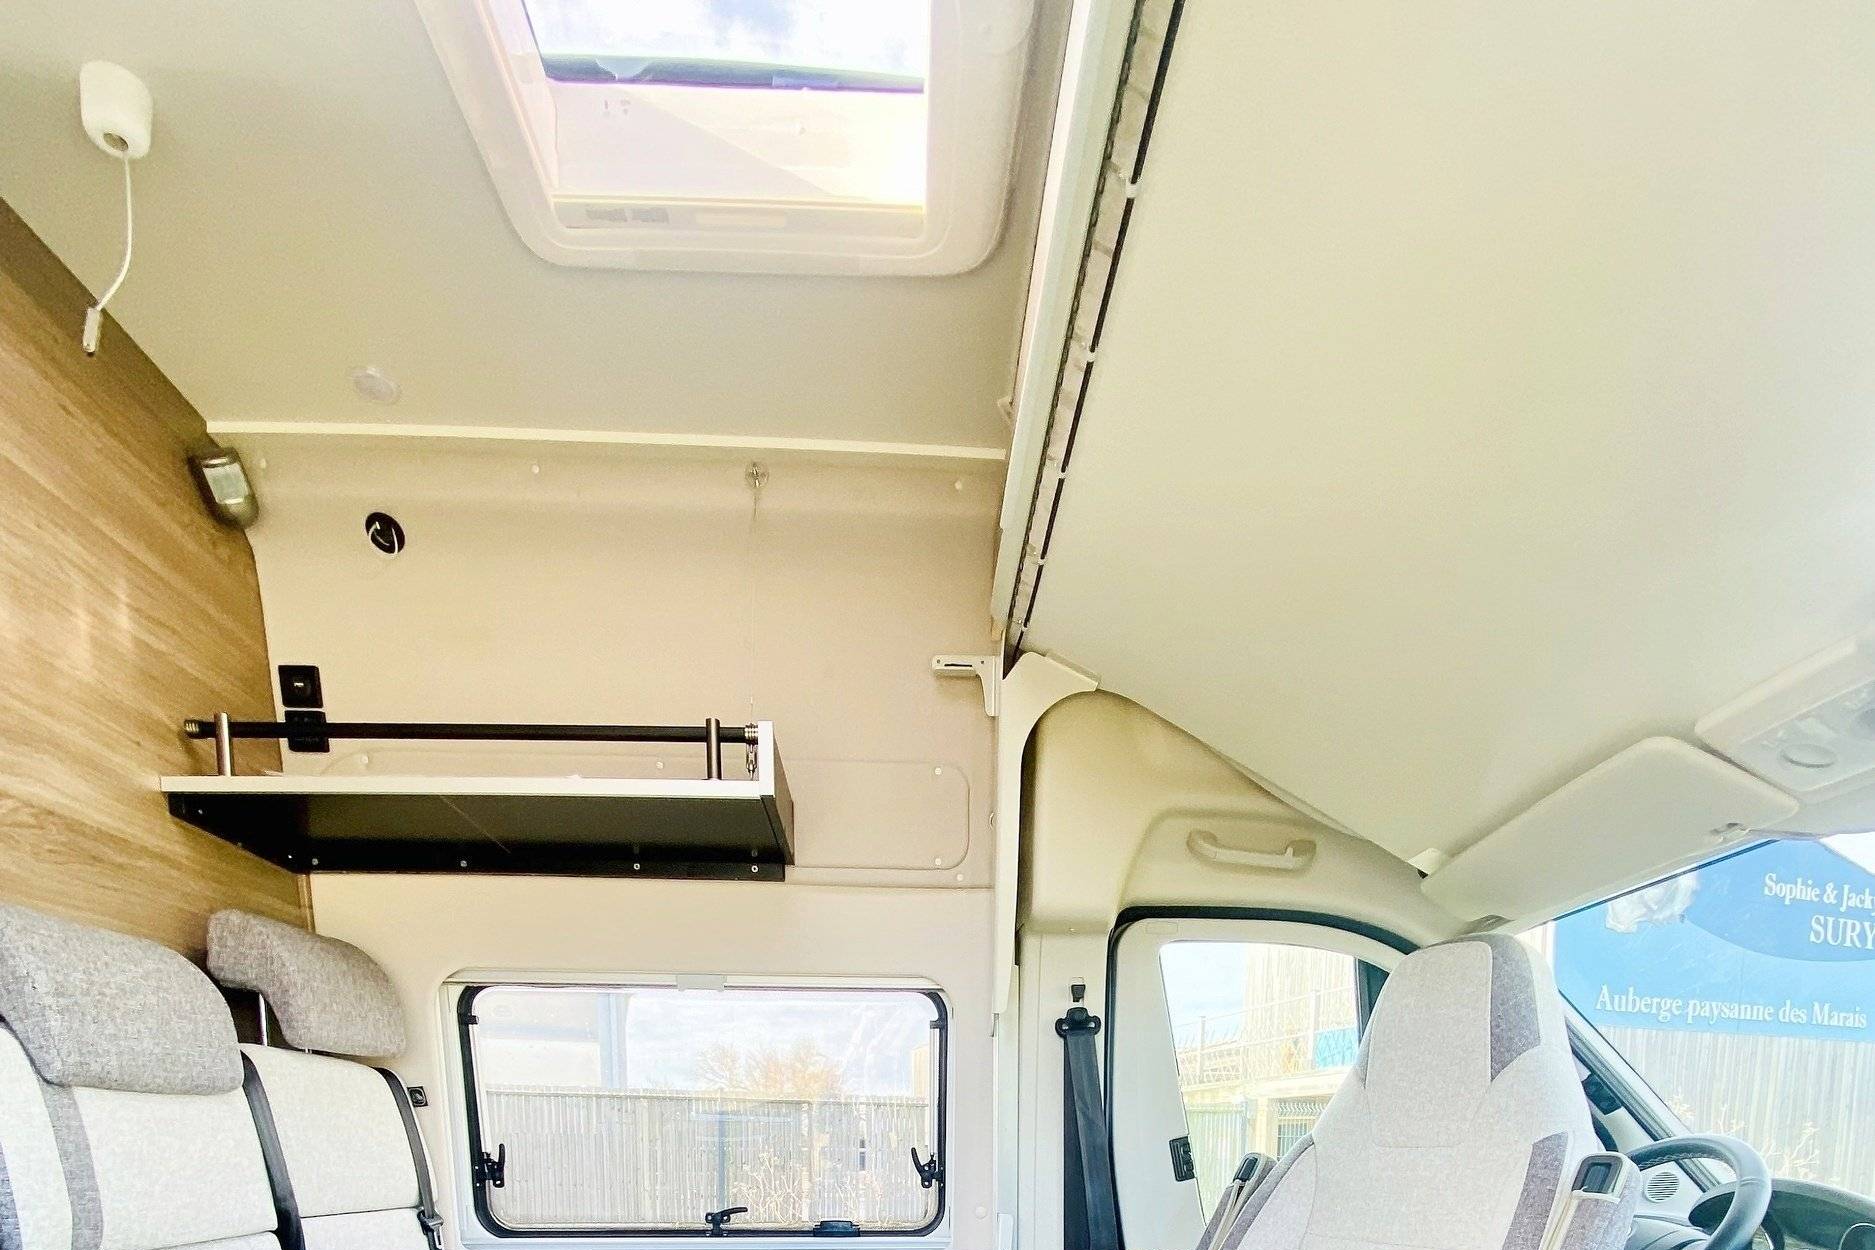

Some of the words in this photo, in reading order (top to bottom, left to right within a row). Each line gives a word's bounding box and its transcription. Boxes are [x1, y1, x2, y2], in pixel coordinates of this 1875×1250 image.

[1763, 872, 1820, 905] Sophie
[1823, 882, 1838, 904] &
[1595, 984, 1683, 1022] Auberge
[1685, 998, 1774, 1025] paysanne
[1778, 999, 1808, 1024] des
[1811, 1001, 1867, 1029] Marais
